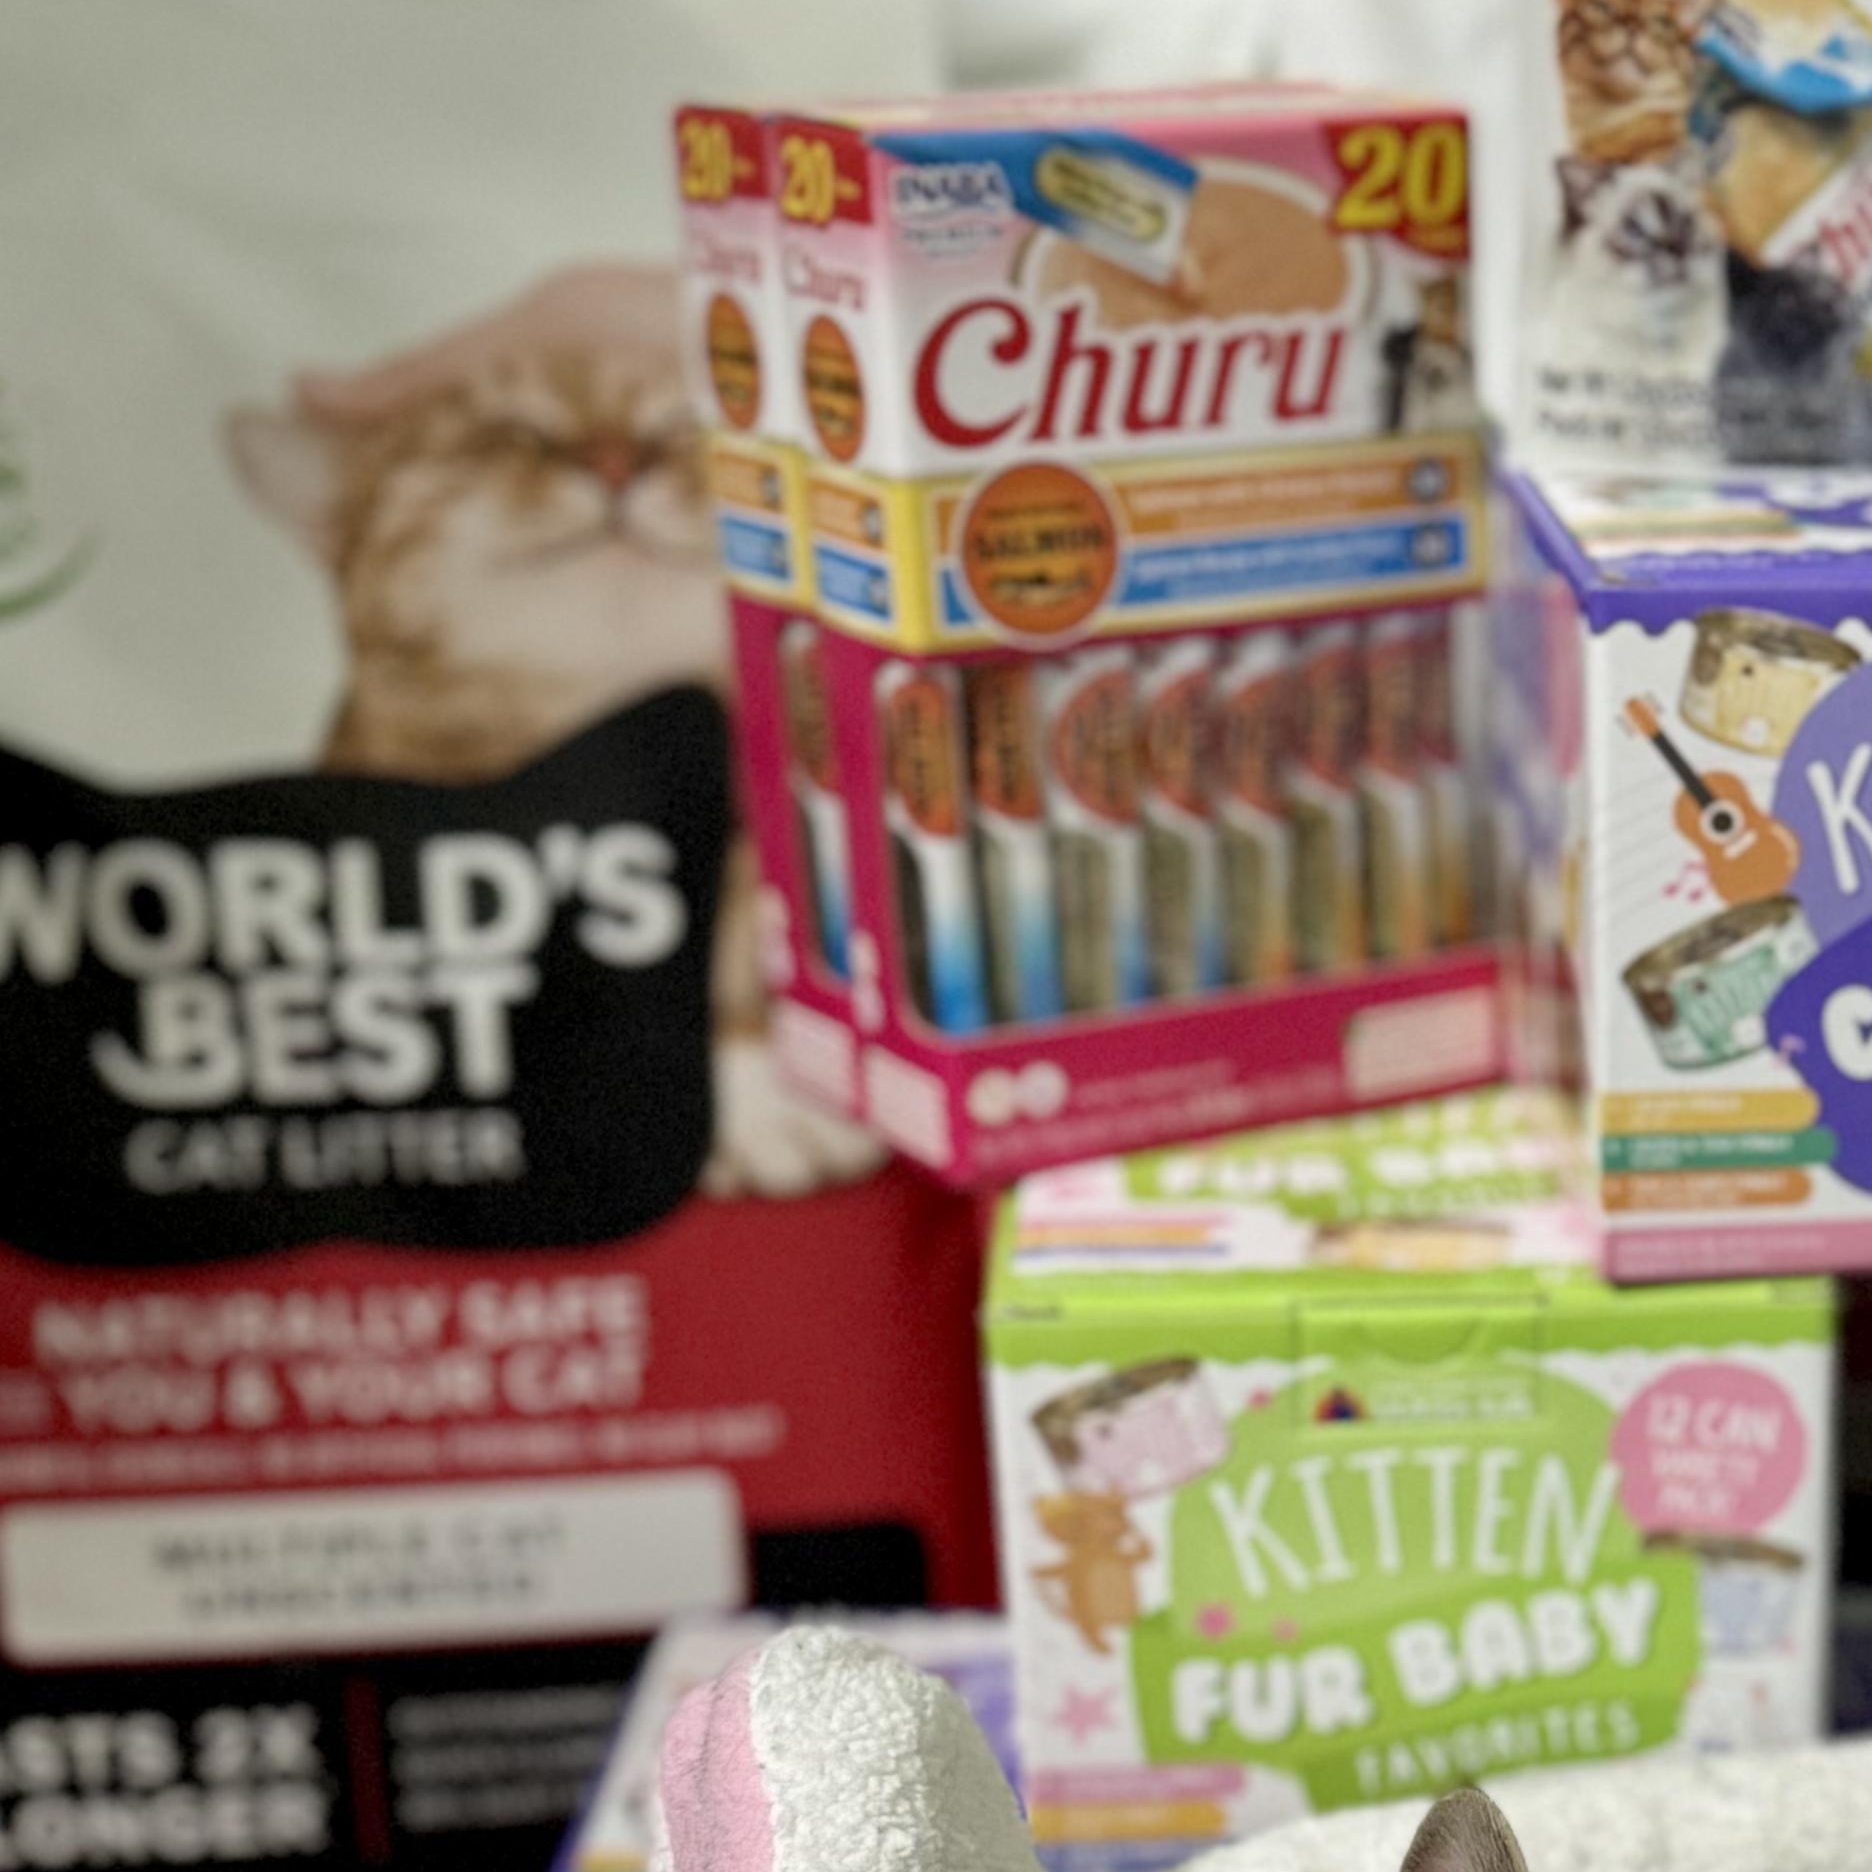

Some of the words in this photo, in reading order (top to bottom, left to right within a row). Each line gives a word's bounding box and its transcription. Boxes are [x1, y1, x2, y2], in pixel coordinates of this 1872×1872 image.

[1334, 121, 1467, 232] 20
[912, 297, 1348, 451] Churu
[0, 822, 687, 983] WORLD'S
[90, 964, 539, 1109] BEST
[124, 1117, 268, 1195] CAT
[281, 1107, 526, 1190] LITTER
[34, 1284, 448, 1364] NATURALLY
[460, 1273, 648, 1340] SAFE
[292, 1351, 495, 1423] YOUR
[1692, 1397, 1782, 1451] CAN
[1208, 1444, 1626, 1600] KITTEN
[1172, 1645, 1376, 1745] FUR
[1388, 1580, 1660, 1708] BABY
[0, 1703, 182, 1793] STS
[1356, 1699, 1641, 1797] FAVORITES
[0, 1786, 328, 1872] ONGER
